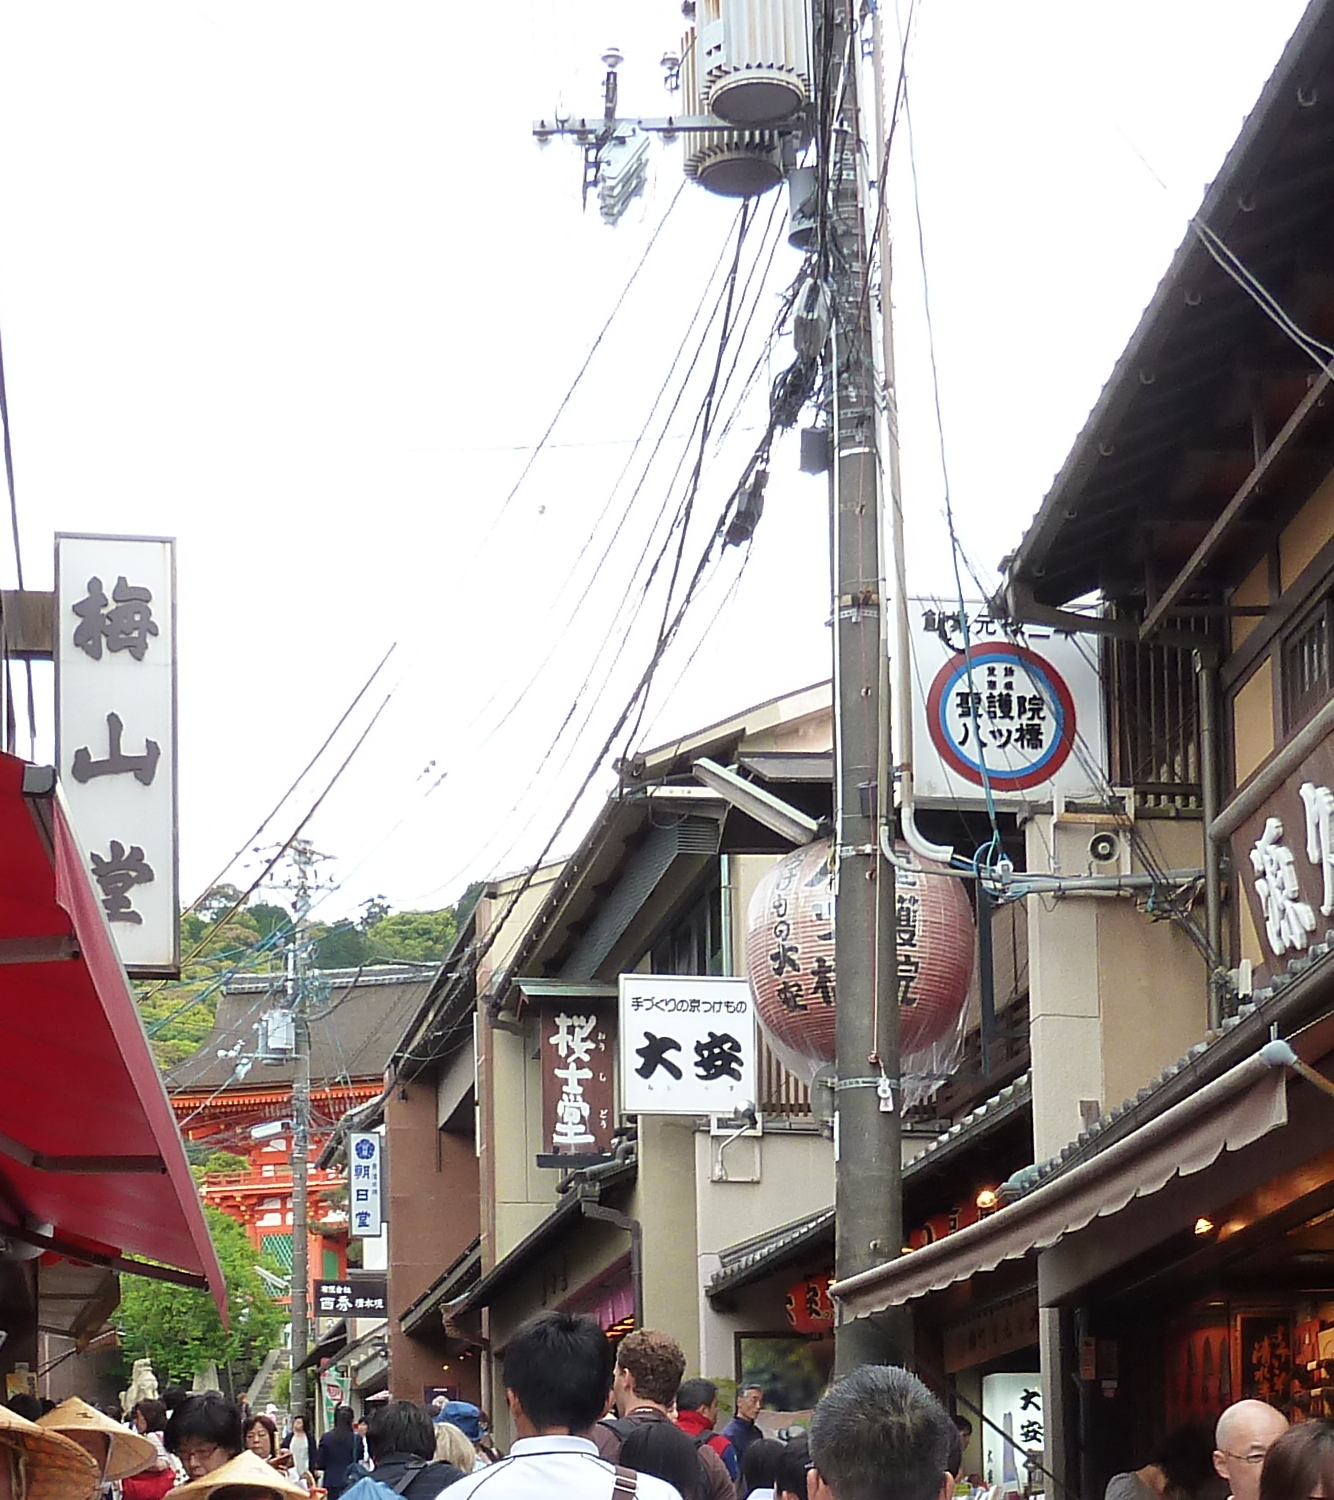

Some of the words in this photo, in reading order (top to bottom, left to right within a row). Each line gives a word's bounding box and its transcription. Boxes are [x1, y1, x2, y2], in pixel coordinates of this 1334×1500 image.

[955, 691, 1046, 721] 聖護院
[72, 575, 160, 926] 梅山堂
[630, 996, 747, 1014] 手づくりの京つけもの
[548, 1012, 597, 1144] 桜士堂
[634, 1031, 745, 1082] 大安
[354, 1163, 371, 1228] 朝日堂
[1019, 1387, 1044, 1444] 大安
